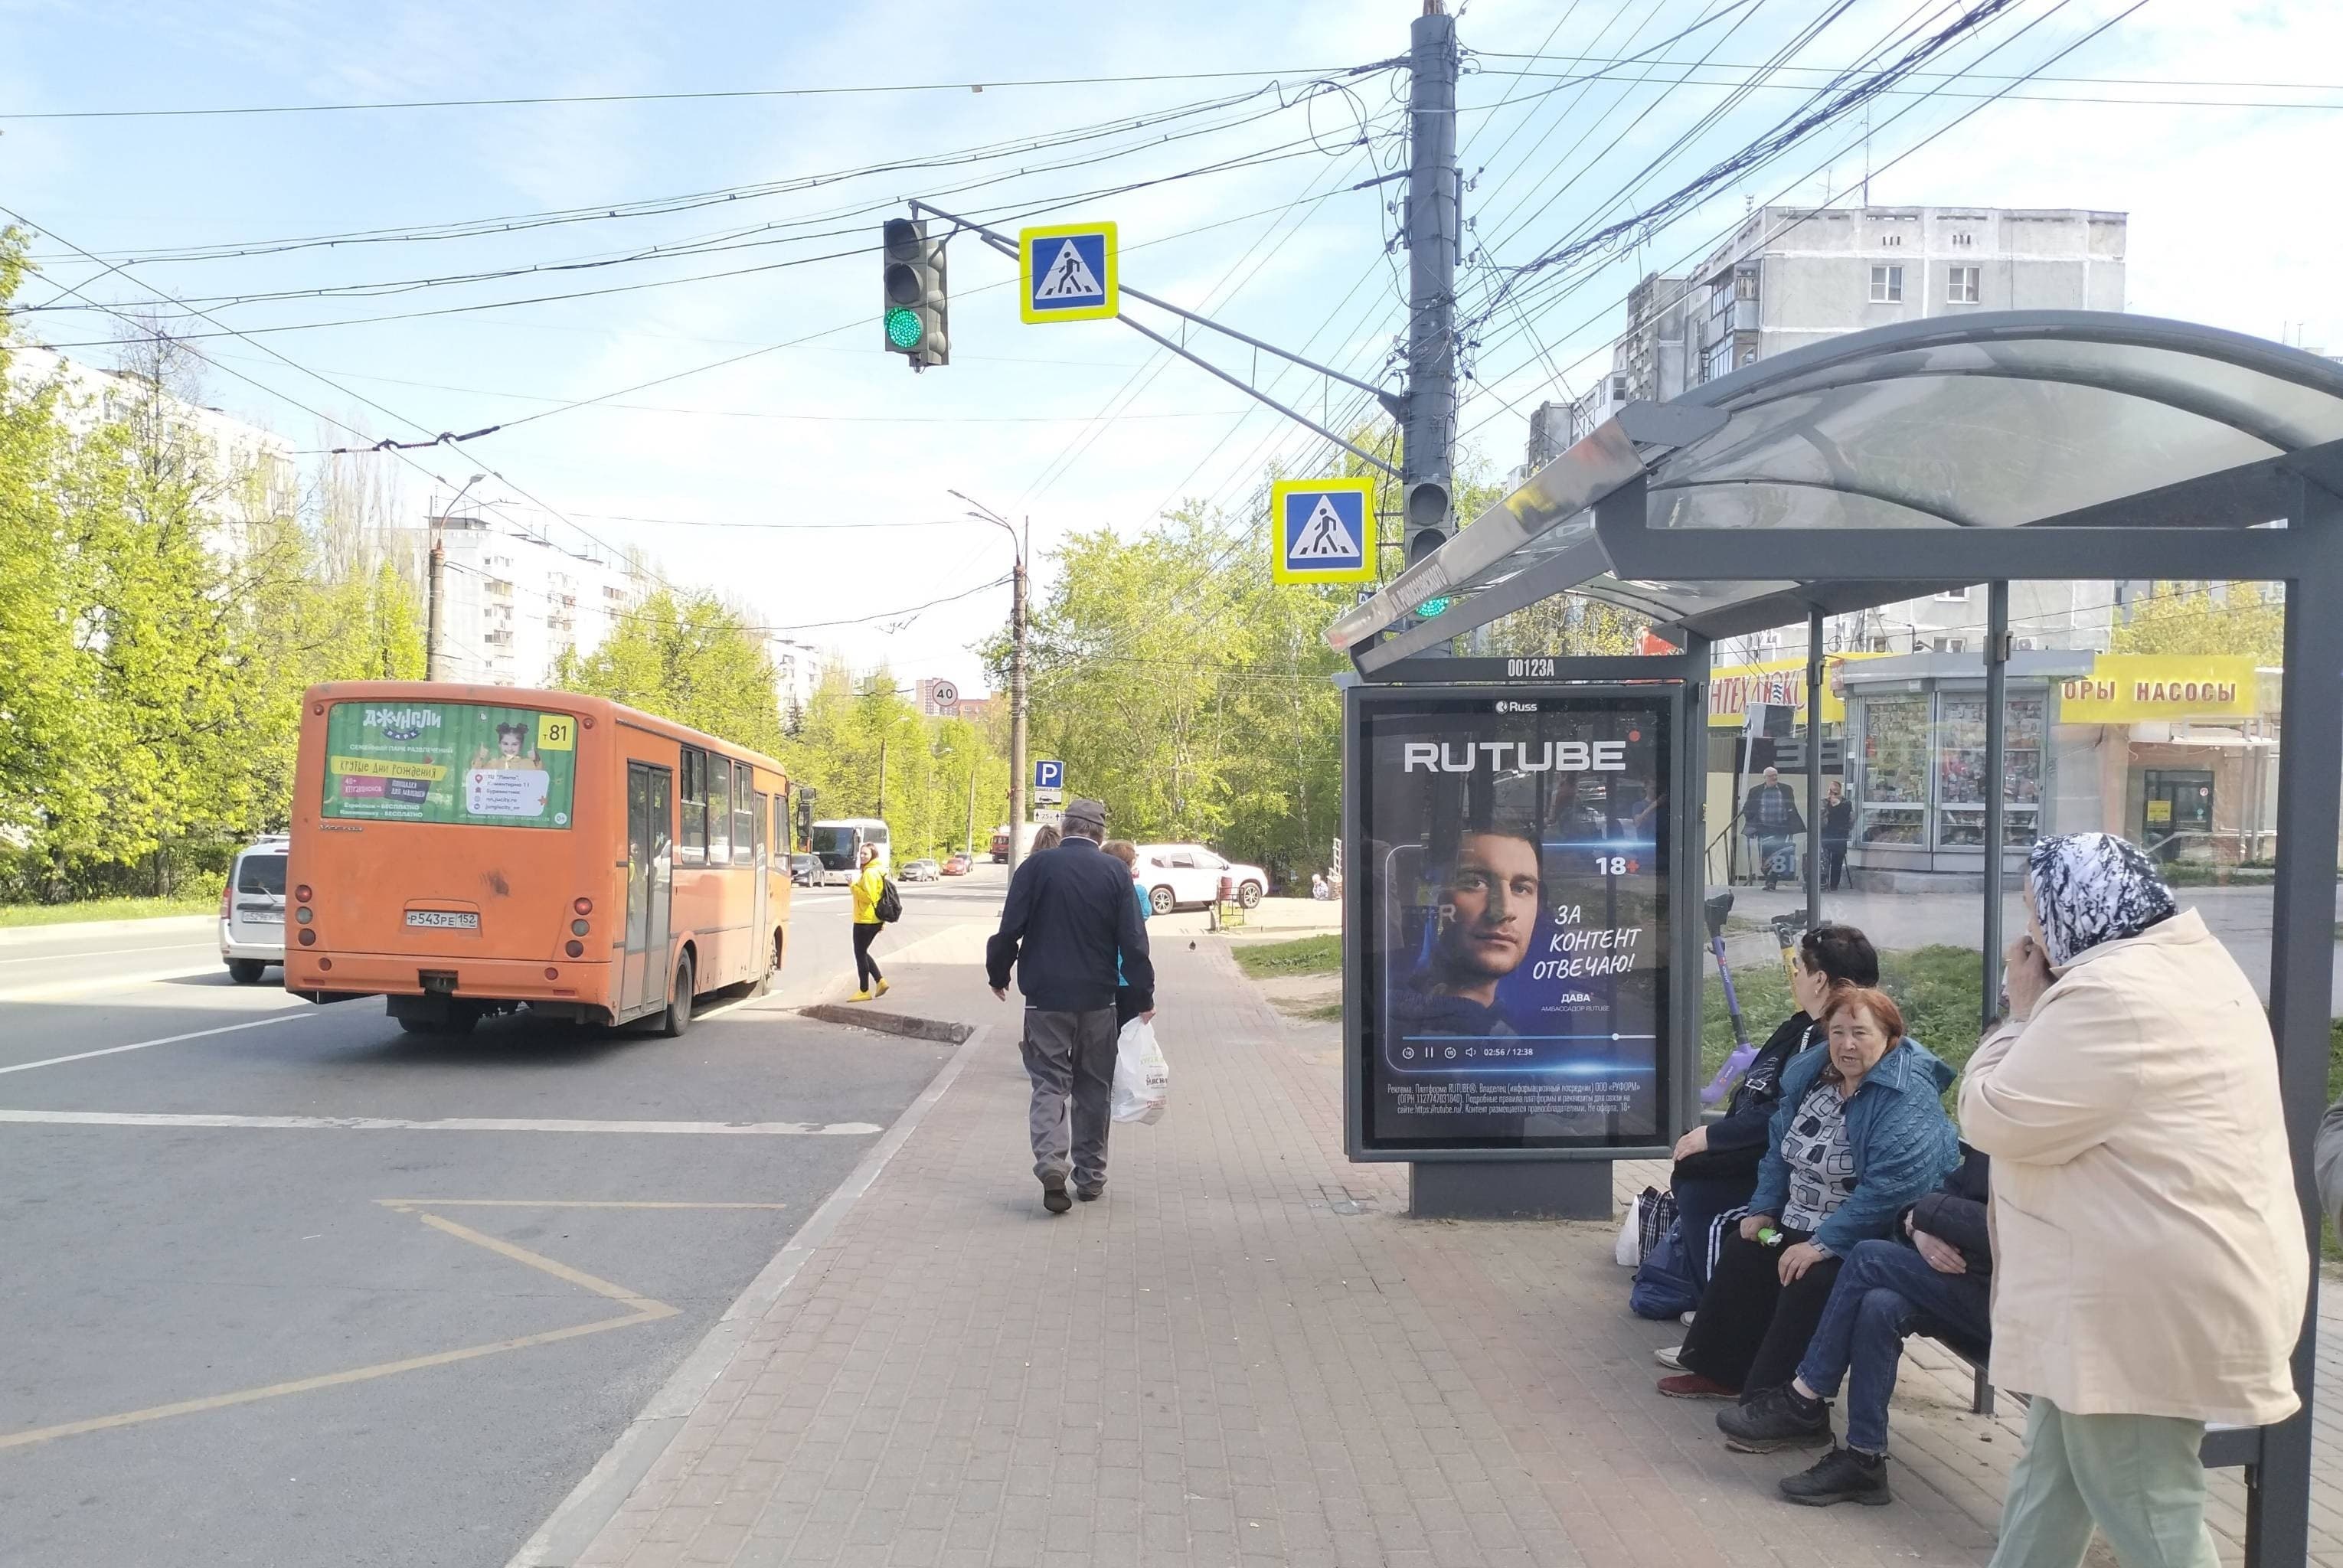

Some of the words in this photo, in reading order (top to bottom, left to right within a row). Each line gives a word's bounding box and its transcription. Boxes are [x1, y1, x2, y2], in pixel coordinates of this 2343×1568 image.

[937, 689, 953, 699] 40
[2136, 682, 2236, 702] НАСОСЫ
[1509, 701, 1537, 712] Russ
[363, 708, 442, 730] ДЖУНГЛИ
[387, 730, 417, 740] ПАРК
[1404, 741, 1626, 773] RUTUBE
[1042, 763, 1057, 785] P
[1596, 857, 1639, 875] 18+
[458, 914, 475, 924] 152
[1554, 905, 1580, 925] ЗА
[1549, 928, 1642, 952] КОНТЕНТ
[1533, 953, 1636, 980] ОТВЕЧАЮ!
[1561, 994, 1590, 1003] ДАВА
[1387, 1083, 1414, 1093] Реклама.
[1415, 1083, 1447, 1095] Платформа
[1479, 1083, 1506, 1093] Владелец
[1595, 1082, 1607, 1091] ООО
[1397, 1093, 1415, 1106] (ОГРН
[1466, 1093, 1498, 1106] Подробные
[1499, 1096, 1523, 1105] правила
[1524, 1094, 1557, 1105] платформы
[1466, 1103, 1487, 1113] Контент
[1488, 1106, 1526, 1115] размещается
[1587, 1102, 1595, 1112] Не
[1619, 1102, 1631, 1112] 18+
